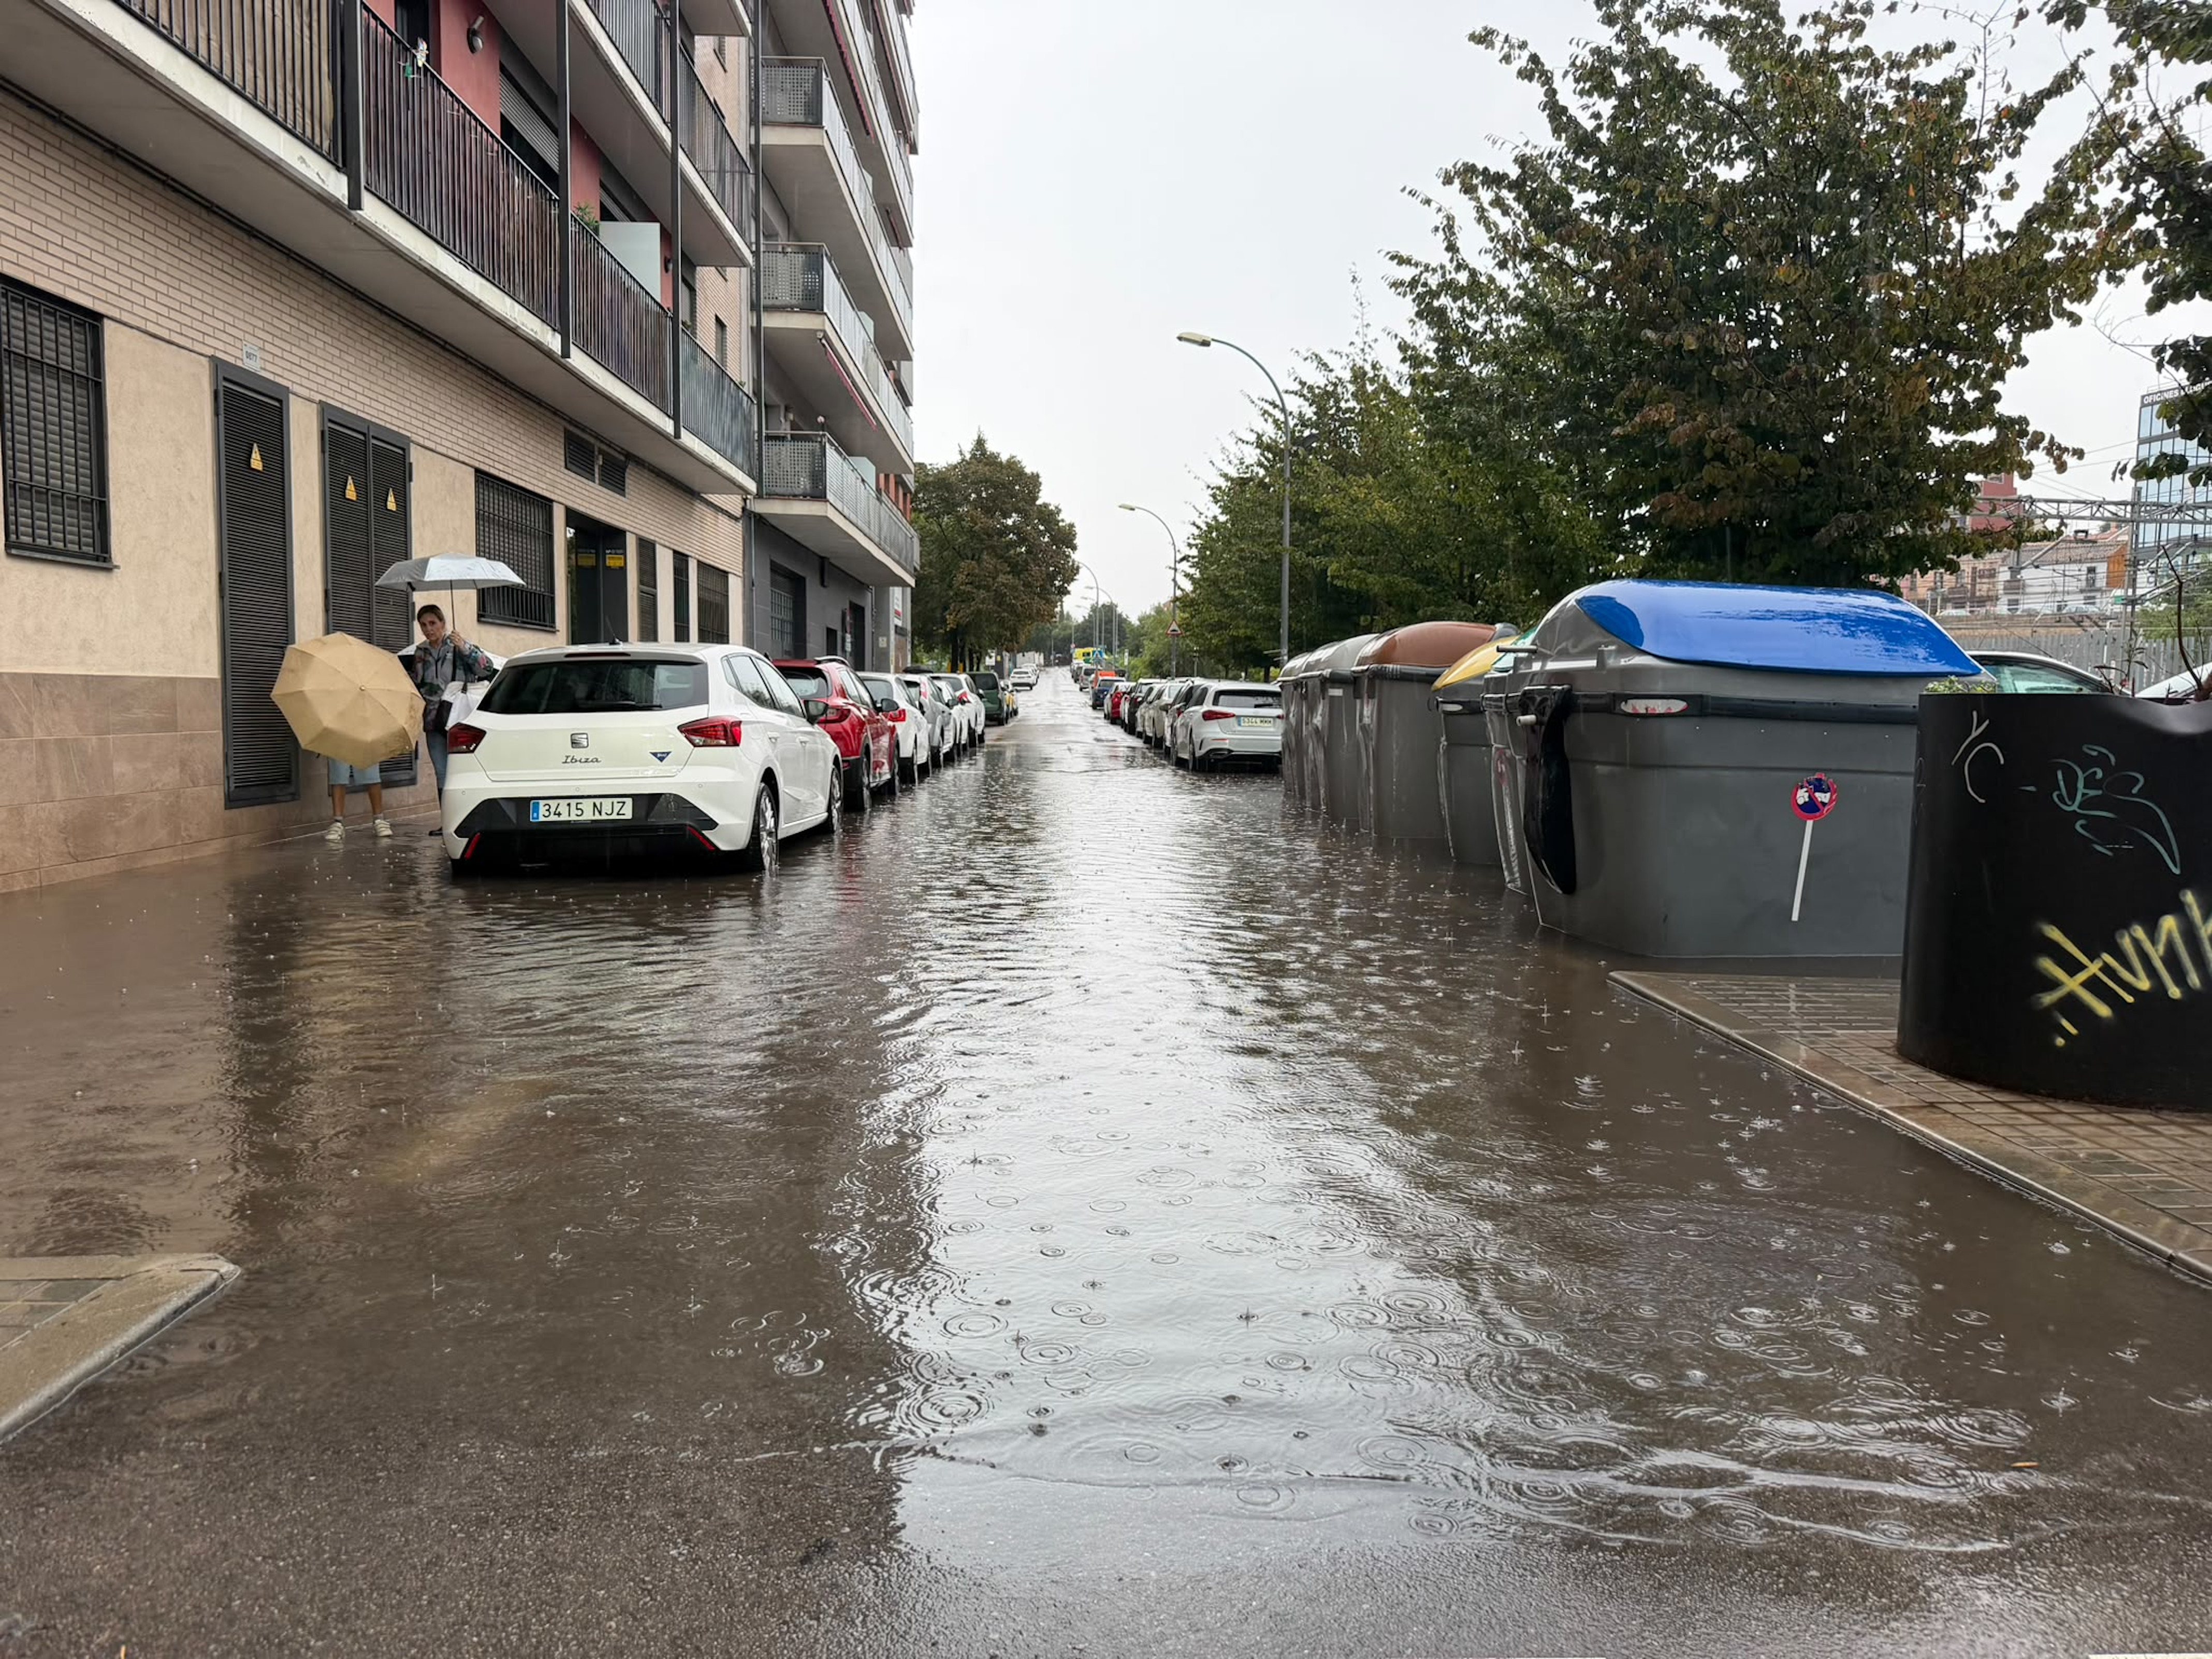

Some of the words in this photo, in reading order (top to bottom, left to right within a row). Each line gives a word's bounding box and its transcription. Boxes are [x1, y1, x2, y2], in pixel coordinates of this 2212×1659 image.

[562, 755, 601, 764] Ibiza
[543, 803, 584, 818] 3415
[593, 801, 626, 817] NJZ
